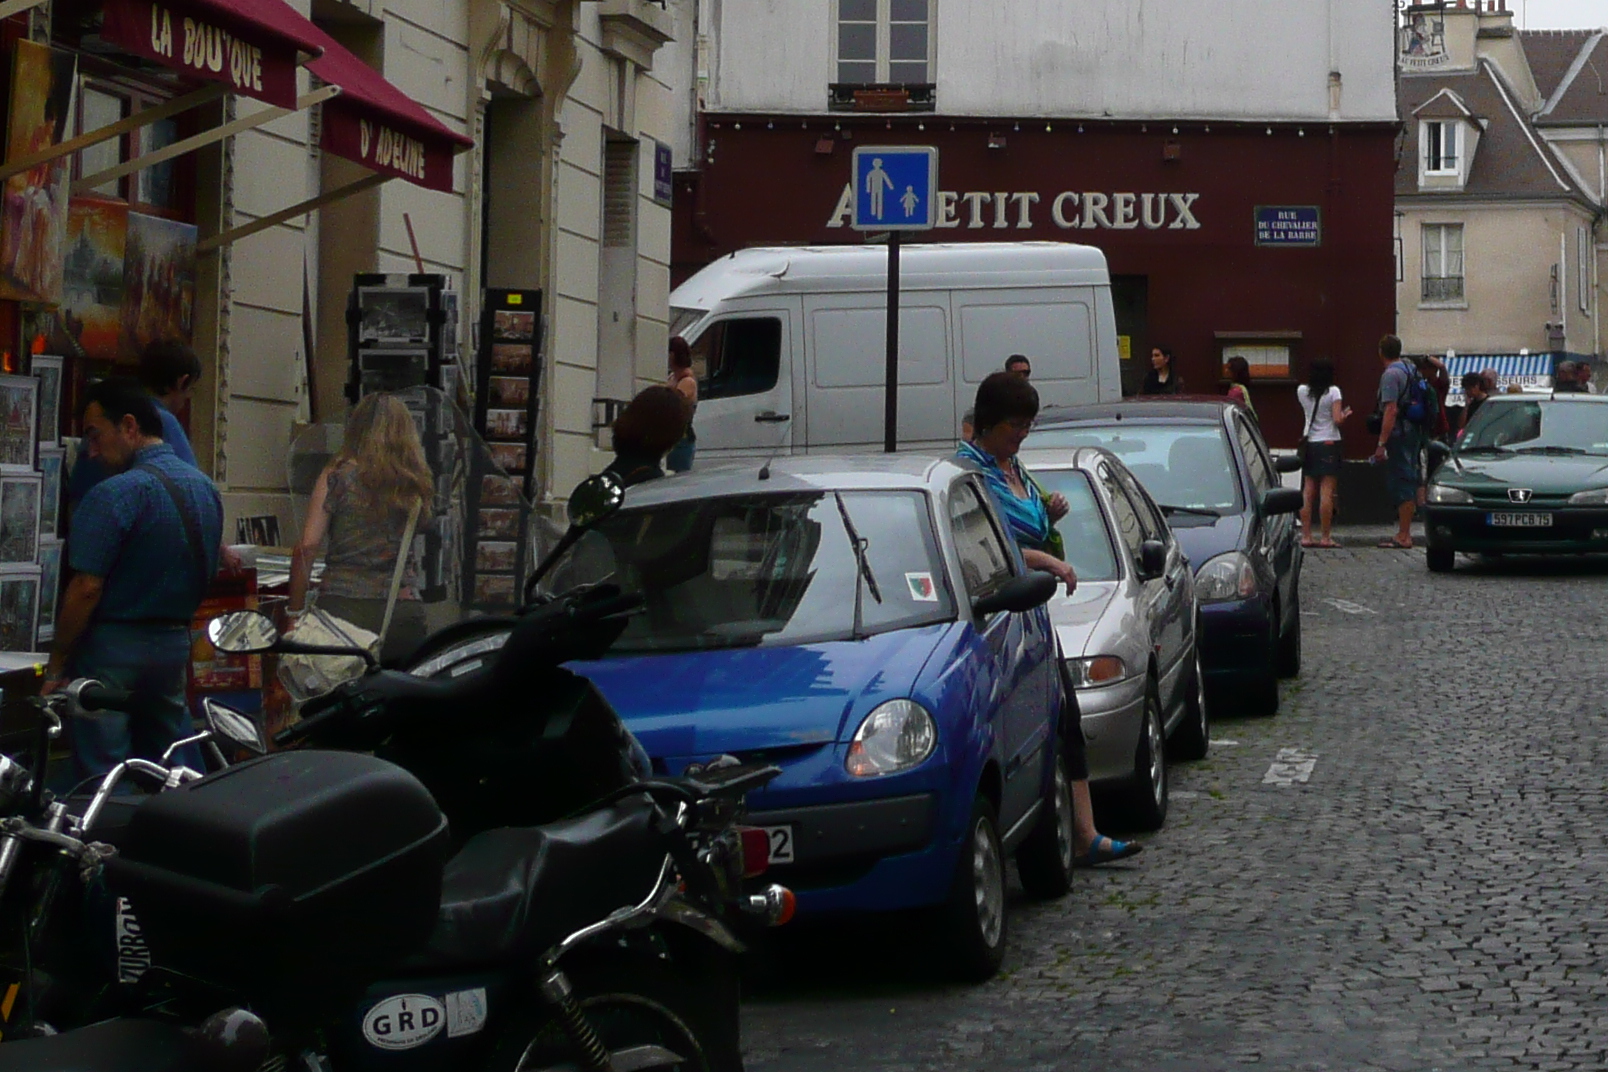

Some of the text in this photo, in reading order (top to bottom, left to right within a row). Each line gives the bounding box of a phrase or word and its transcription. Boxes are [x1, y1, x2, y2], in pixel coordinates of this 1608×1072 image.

[151, 2, 172, 58] LA
[375, 125, 426, 180] ADELINE
[1051, 192, 1201, 229] CREUX
[1278, 211, 1297, 220] RUE
[1258, 221, 1318, 230] DU CHEVALIER
[1259, 231, 1317, 240] DE LA BARRE
[372, 1007, 439, 1036] GRD
